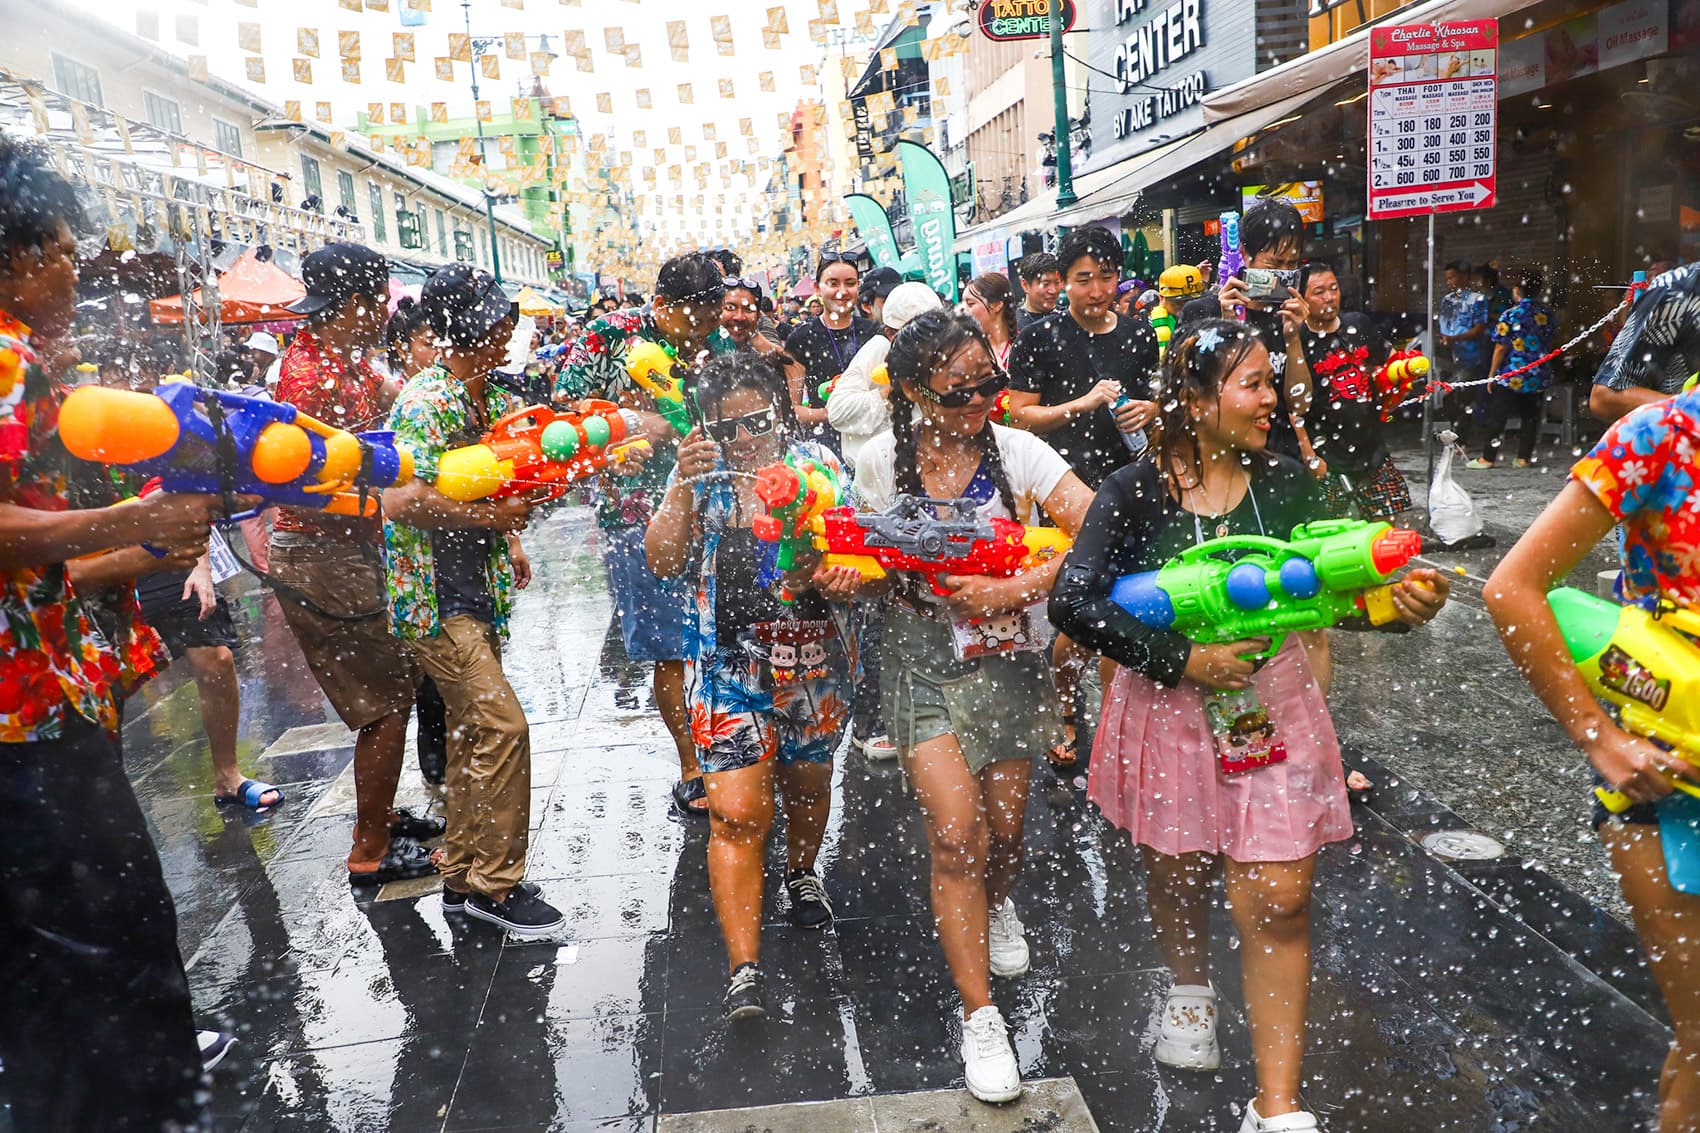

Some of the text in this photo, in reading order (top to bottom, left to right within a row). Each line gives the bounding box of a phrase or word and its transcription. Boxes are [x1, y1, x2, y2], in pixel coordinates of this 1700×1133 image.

[991, 0, 1063, 17] TATTO
[992, 16, 1064, 35] CENTE
[1391, 25, 1479, 42] Charlie Khaosan
[1113, 0, 1201, 94] CENTER
[1407, 42, 1440, 51] Massage
[1451, 39, 1465, 50] Spa
[1606, 26, 1658, 50] Oil Massage
[1398, 87, 1415, 95] THAI
[1423, 84, 1442, 93] FOOT
[1113, 110, 1127, 139] BY
[1131, 97, 1152, 131] AKE
[1156, 71, 1204, 119] TATTOO
[1398, 120, 1415, 133] 180
[1424, 117, 1441, 130] 180
[1450, 115, 1466, 128] 250
[1474, 113, 1490, 125] 200
[1397, 137, 1415, 150] 300
[1423, 135, 1441, 148] 300
[1449, 132, 1466, 144] 400
[1474, 130, 1490, 143] 350
[1397, 155, 1415, 167] 450
[1423, 152, 1440, 165] 450
[1449, 149, 1465, 162] 550
[1473, 147, 1489, 160] 550
[1397, 171, 1414, 184] 600
[1423, 169, 1440, 182] 600
[1449, 166, 1465, 179] 700
[1473, 163, 1489, 176] 700
[1379, 198, 1416, 208] Pleasure
[1431, 193, 1455, 203] Serve
[1458, 190, 1474, 200] You
[1185, 275, 1194, 288] P
